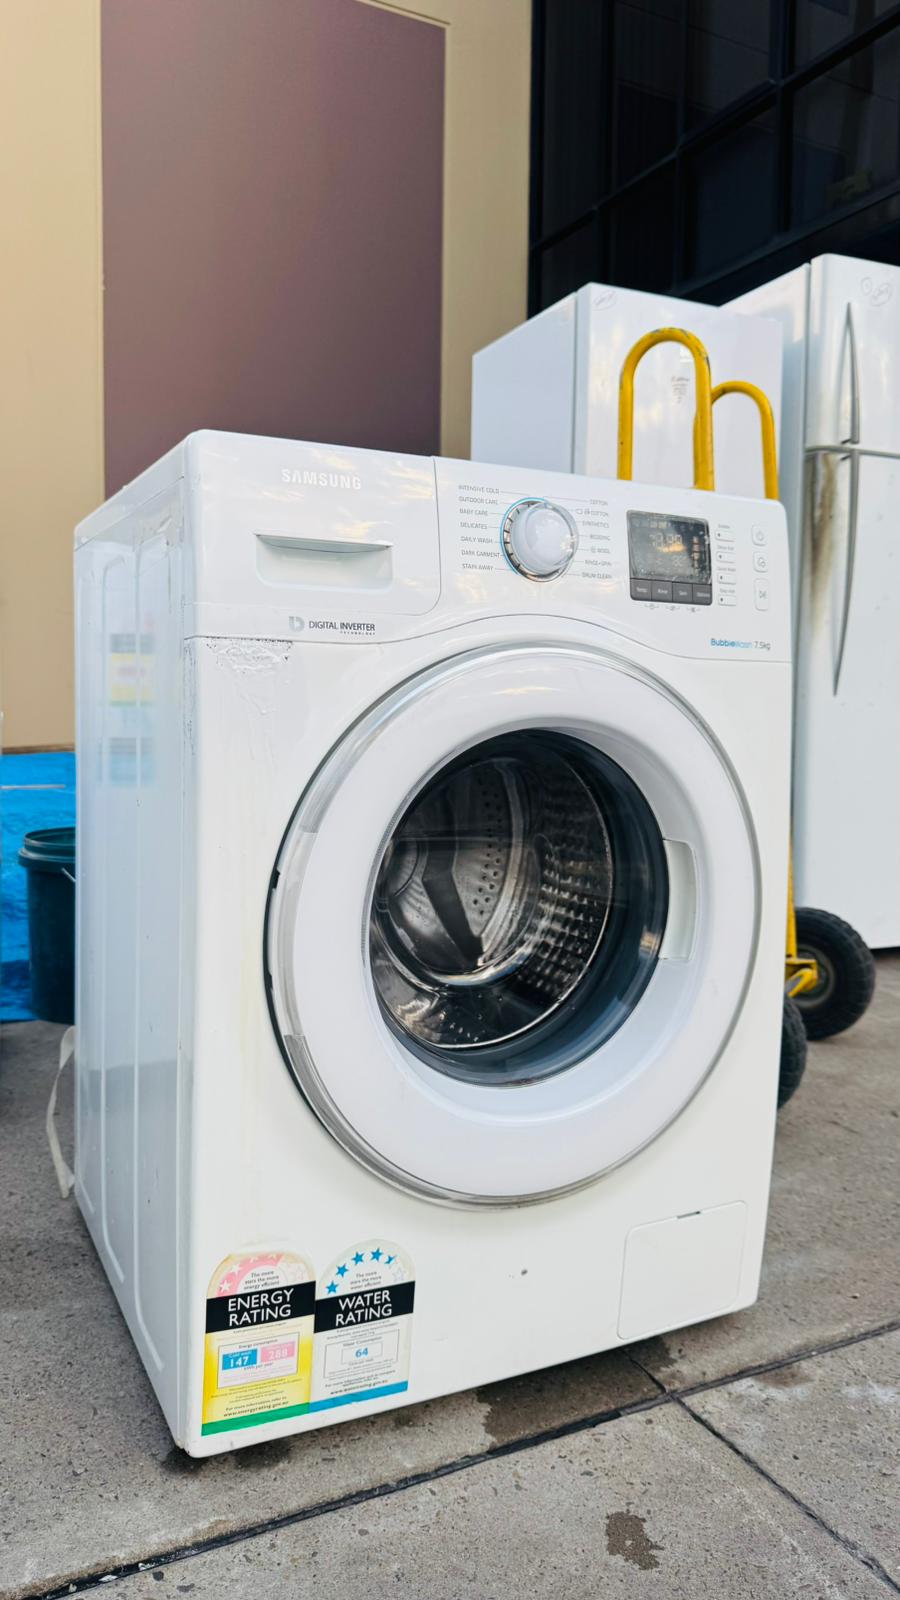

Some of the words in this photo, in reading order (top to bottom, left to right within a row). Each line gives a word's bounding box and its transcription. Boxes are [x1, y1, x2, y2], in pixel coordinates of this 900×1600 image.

[280, 468, 361, 490] SAMSUNG
[458, 496, 485, 504] OUTDOOR
[460, 522, 488, 530] DELICATES
[461, 549, 475, 557] DARK
[478, 564, 494, 572] AWAY
[308, 620, 339, 630] DIGITAL
[339, 622, 376, 632] INVERTER
[228, 1287, 295, 1312] ENERGY
[338, 1289, 391, 1311] WATER
[229, 1304, 292, 1327] RATING
[335, 1303, 392, 1327] RATING
[355, 1347, 369, 1358] 64
[229, 1356, 250, 1368] 147
